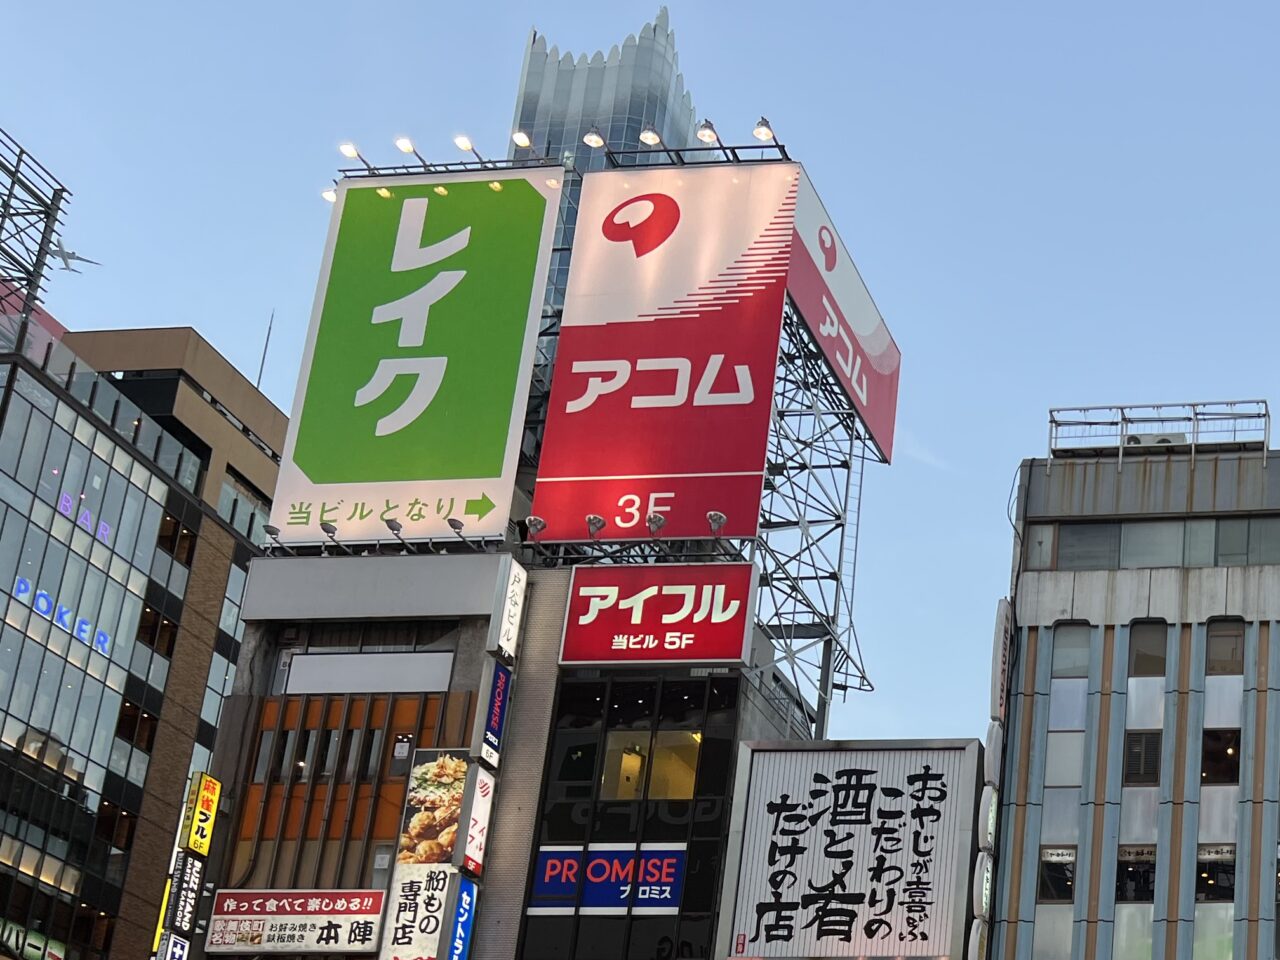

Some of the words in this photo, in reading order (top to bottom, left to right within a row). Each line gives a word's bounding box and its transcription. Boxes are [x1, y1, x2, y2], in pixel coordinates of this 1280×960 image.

[354, 198, 470, 436] レイク
[819, 295, 867, 406] アコム
[565, 354, 755, 413] アコム
[59, 491, 110, 543] BAR
[287, 497, 457, 526] 当ビルとなり
[615, 492, 675, 528] 3F
[14, 577, 110, 654] POKER
[578, 585, 740, 625] アイフル
[612, 635, 658, 649] 当ビル
[664, 632, 694, 649] 5F
[491, 671, 506, 730] PROMISE
[193, 840, 204, 850] 6F
[544, 858, 677, 883] PROMISE
[749, 794, 813, 943] だけの店
[863, 787, 905, 939] こだわりの
[391, 880, 422, 945] 専門店
[419, 870, 448, 935] 粉もの
[620, 884, 672, 900] プロミス
[268, 922, 317, 933] お好み焼き
[316, 920, 375, 945] 本陣
